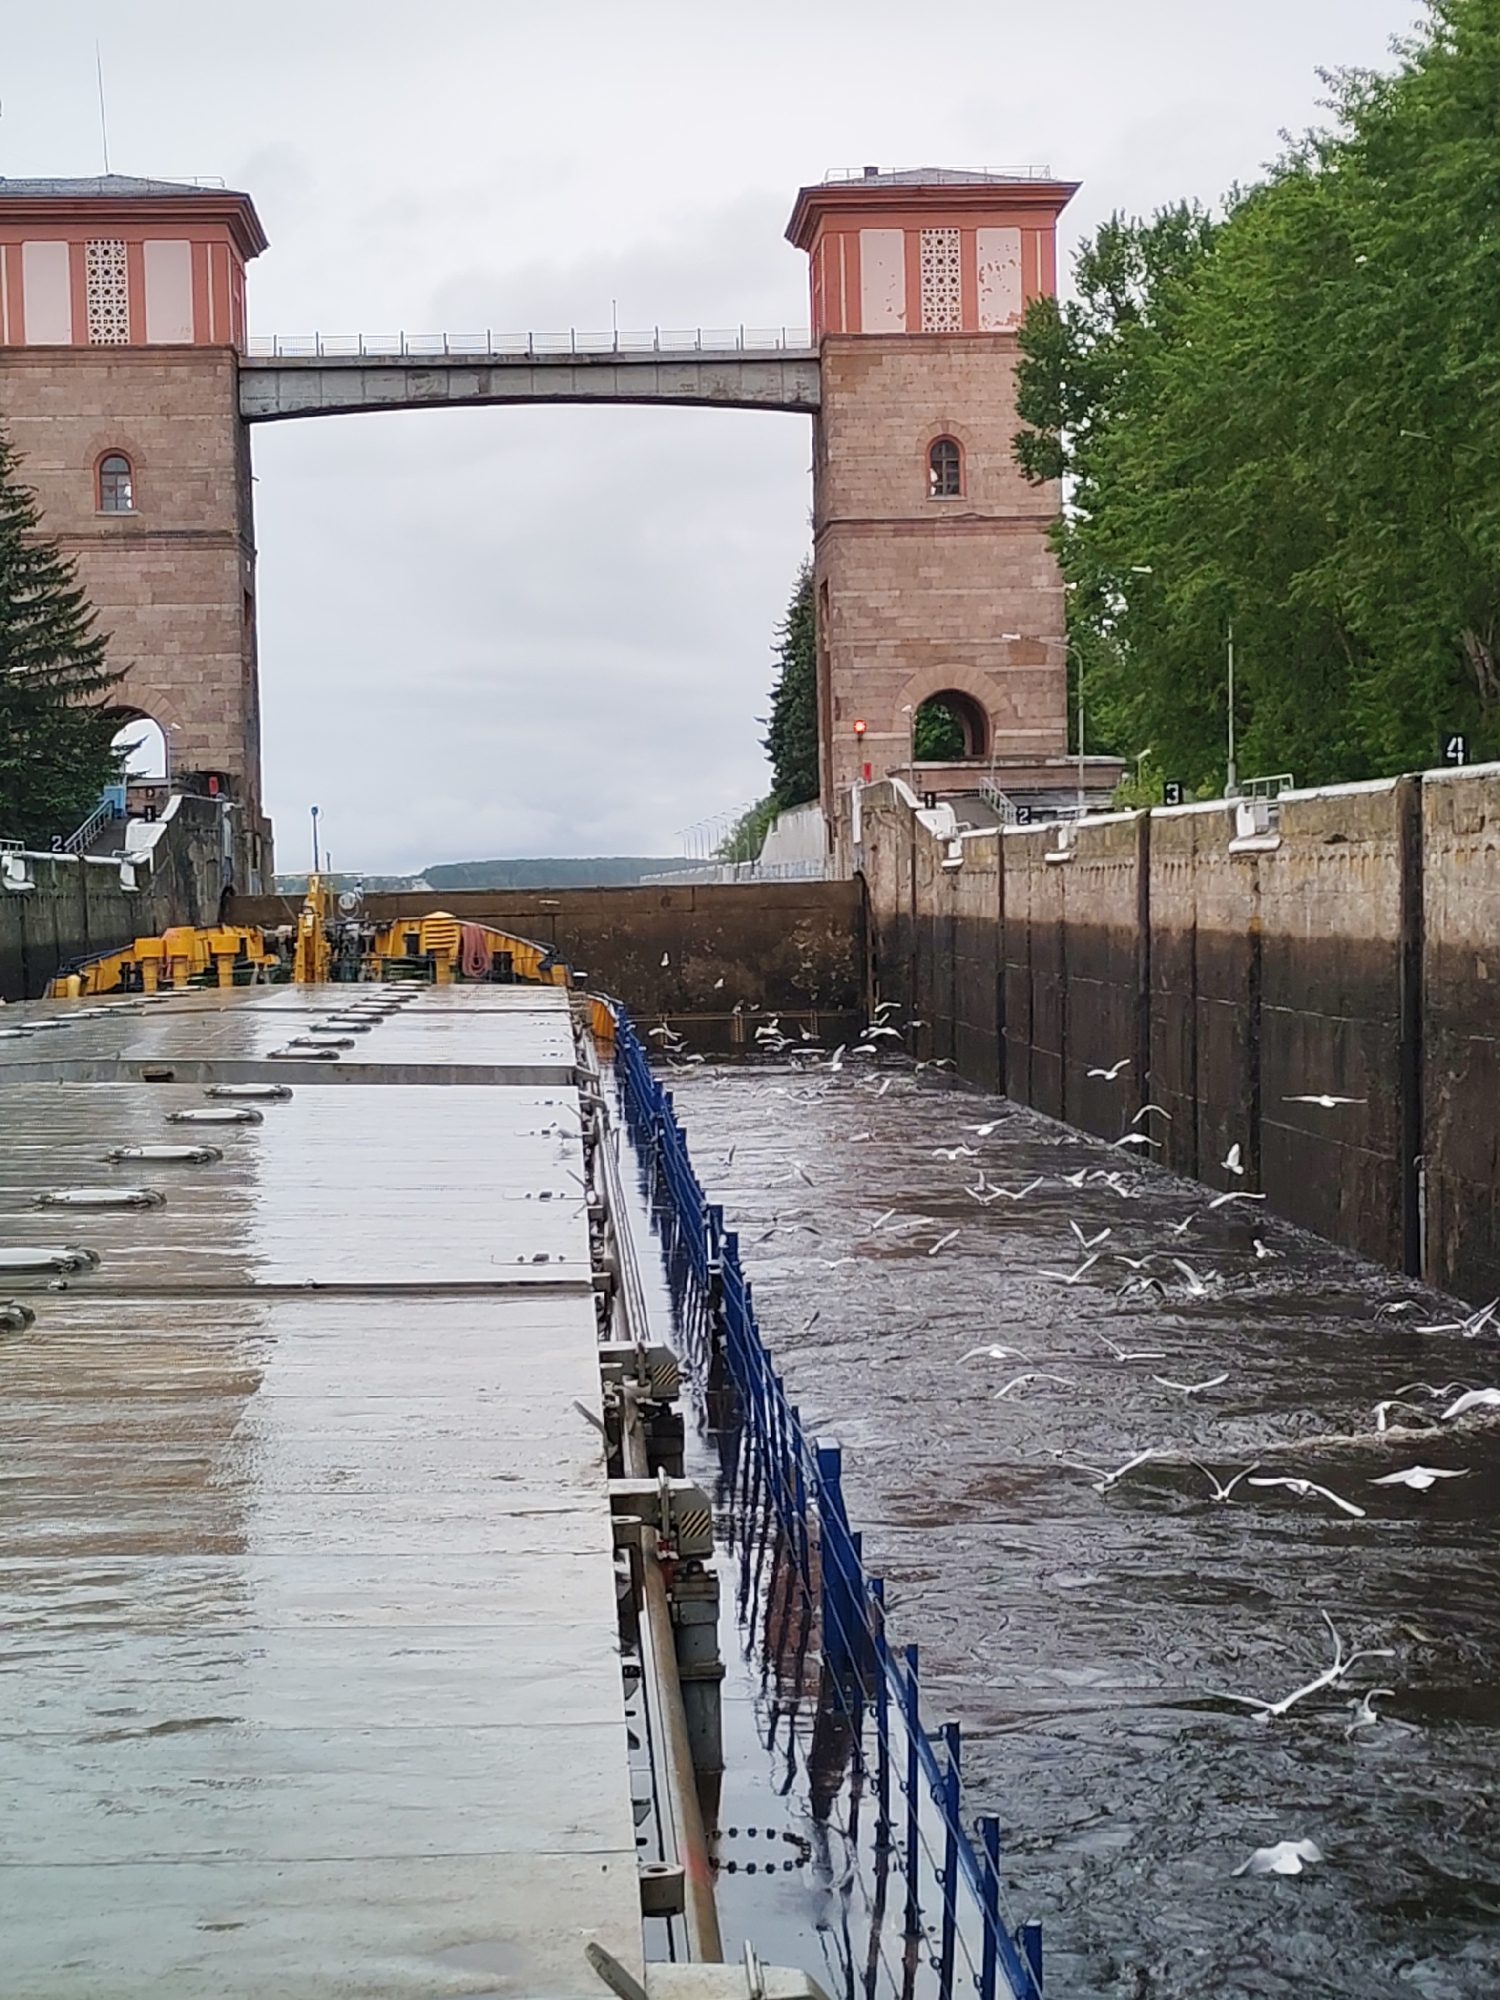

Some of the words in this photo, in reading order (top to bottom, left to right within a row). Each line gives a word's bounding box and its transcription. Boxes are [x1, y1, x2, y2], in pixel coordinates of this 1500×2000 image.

[1446, 736, 1465, 765] 4
[1166, 783, 1179, 804] 3
[1018, 807, 1029, 824] 2
[51, 835, 62, 852] 2
